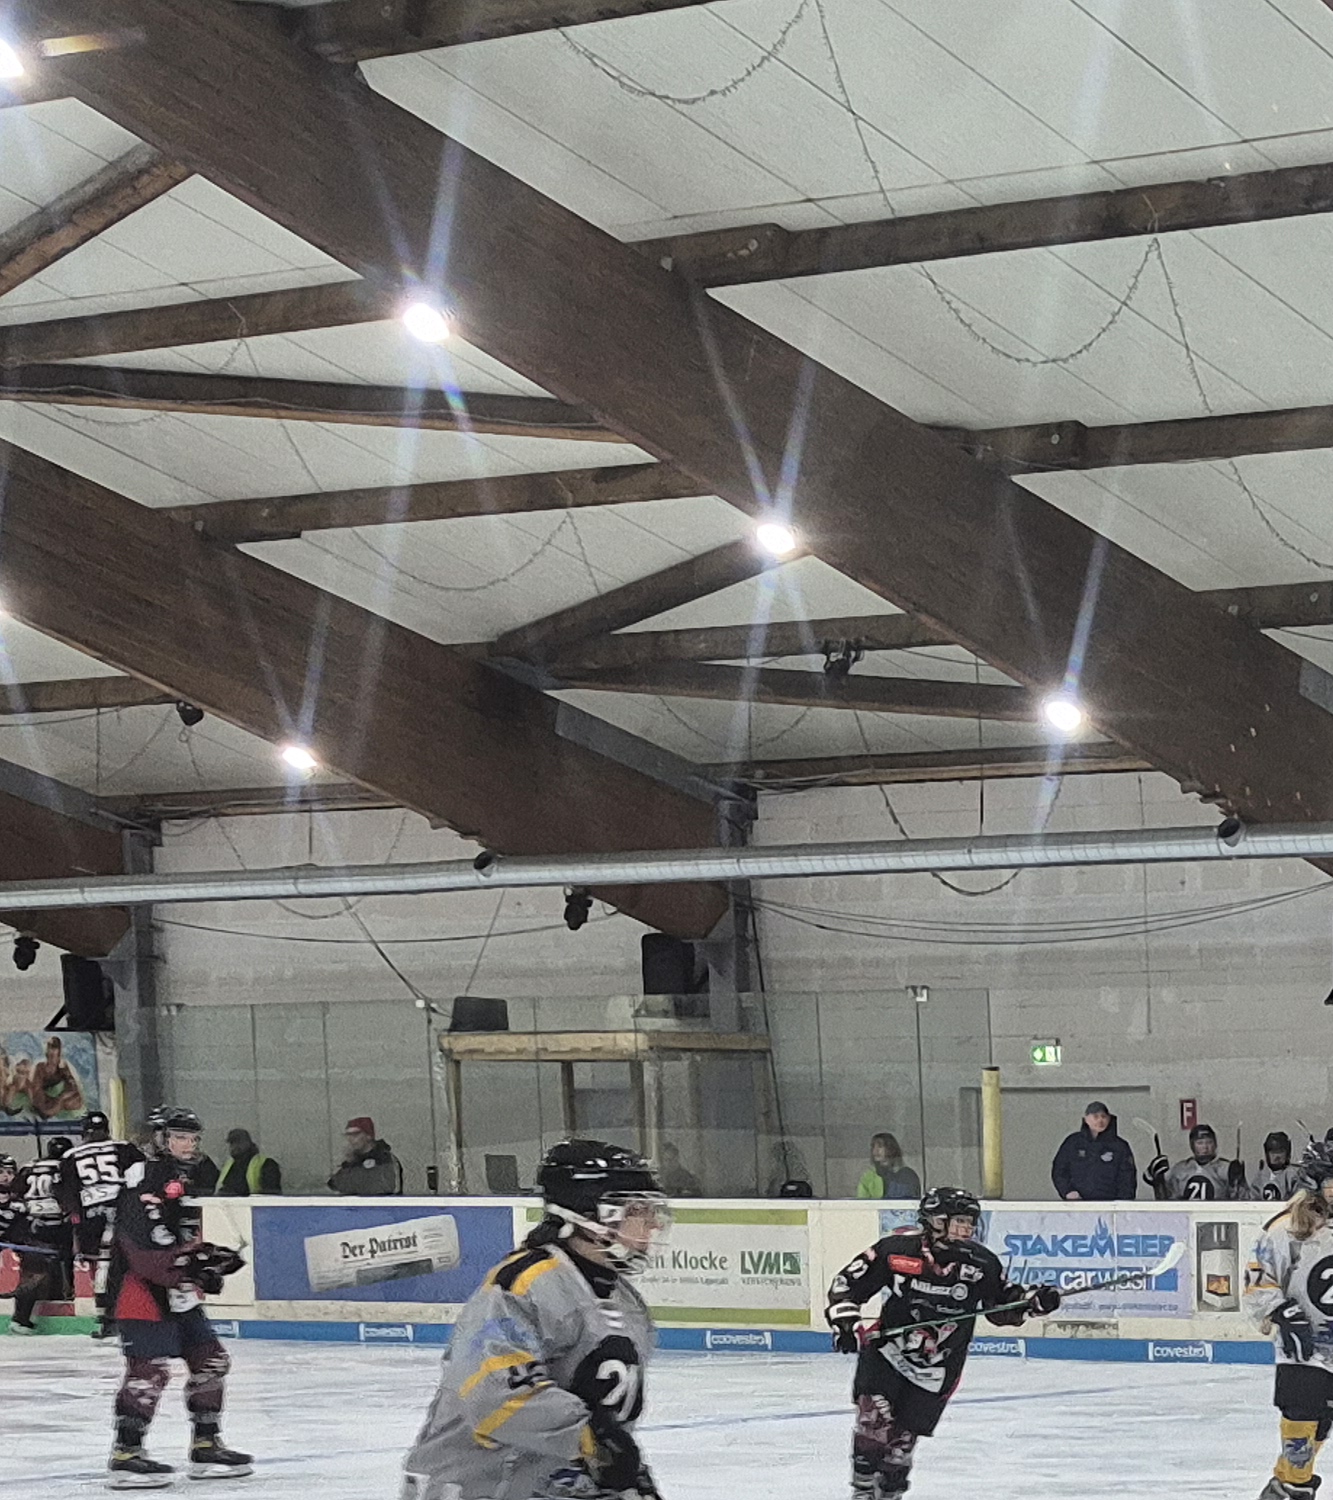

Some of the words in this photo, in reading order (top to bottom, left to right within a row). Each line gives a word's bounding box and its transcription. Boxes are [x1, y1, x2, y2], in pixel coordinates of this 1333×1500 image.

[1183, 1102, 1194, 1127] F
[75, 1154, 120, 1185] 55
[339, 1241, 366, 1260] Der
[1001, 1233, 1176, 1259] STAKEMEIER
[672, 1250, 729, 1271] Klocke
[740, 1250, 780, 1276] LVM
[1153, 1341, 1206, 1357] covestro
